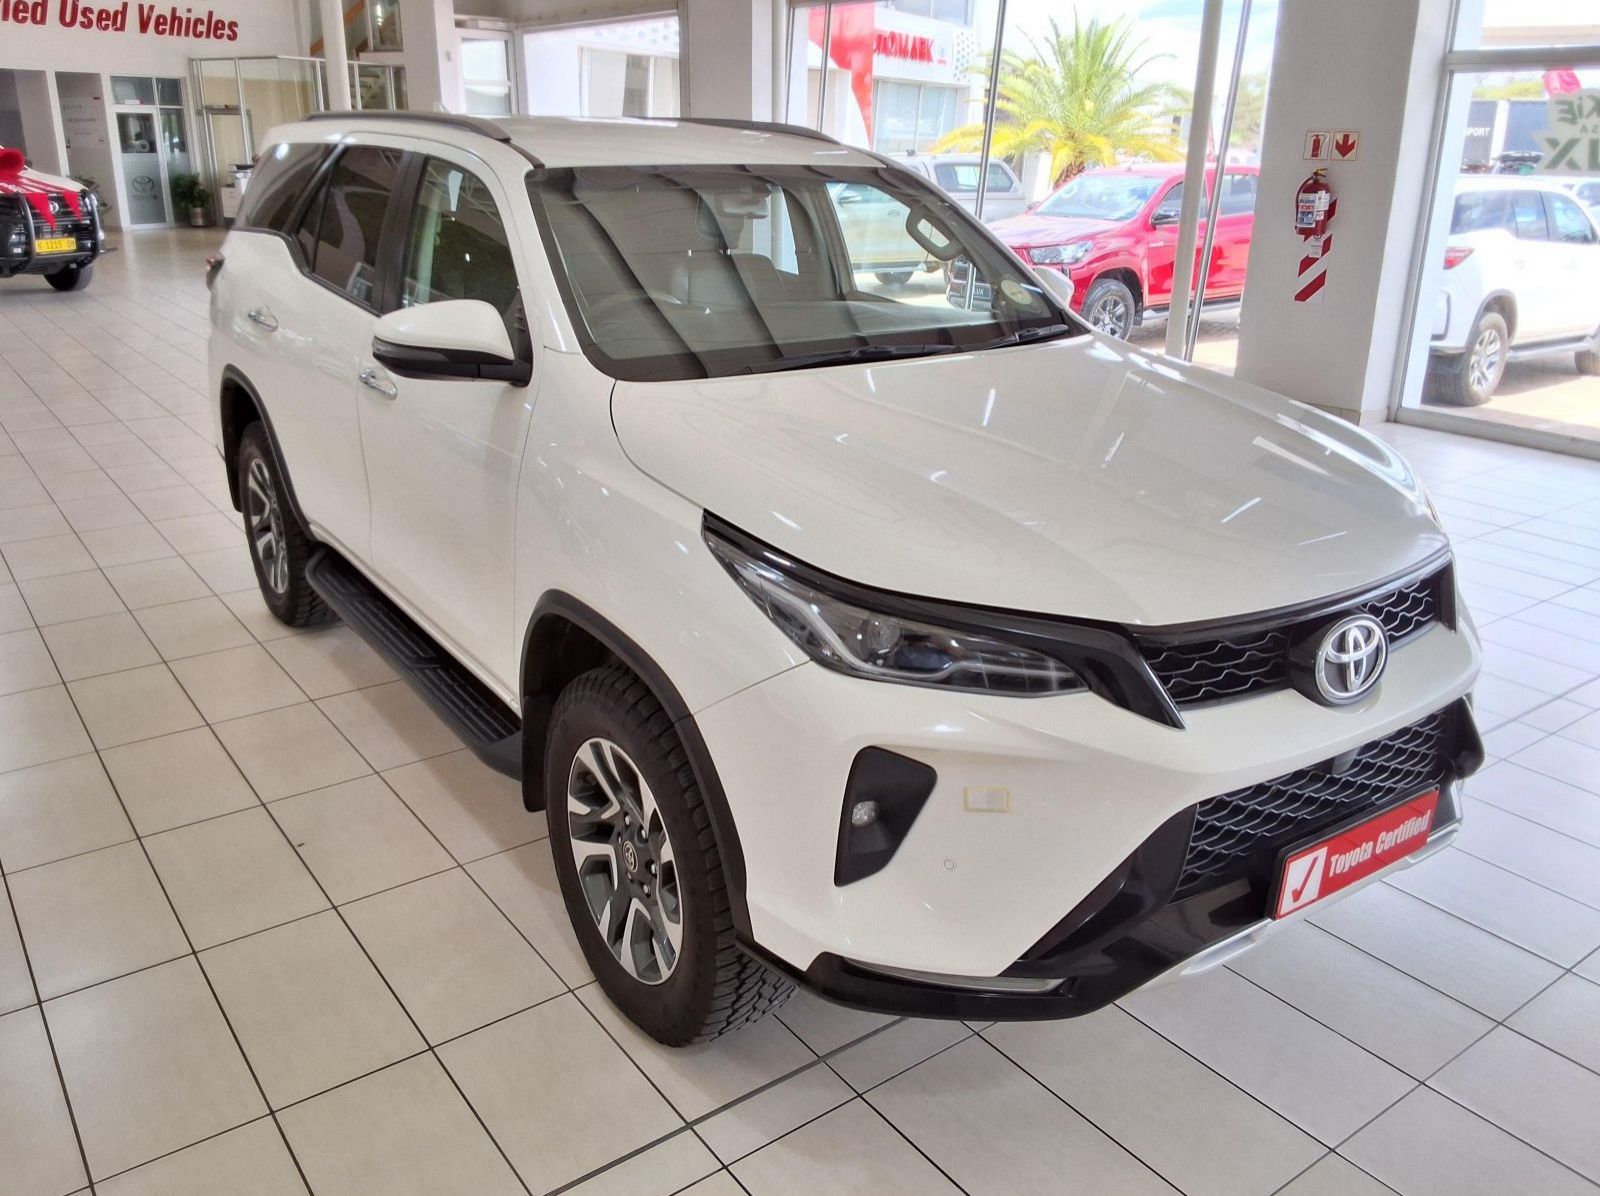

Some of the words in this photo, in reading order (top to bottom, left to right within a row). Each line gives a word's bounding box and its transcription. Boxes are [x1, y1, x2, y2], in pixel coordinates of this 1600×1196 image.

[0, 0, 48, 26] ied
[59, 0, 128, 32] Used
[138, 3, 239, 42] Vehicles
[1329, 840, 1374, 878] Toyota
[1375, 809, 1432, 855] Certified
